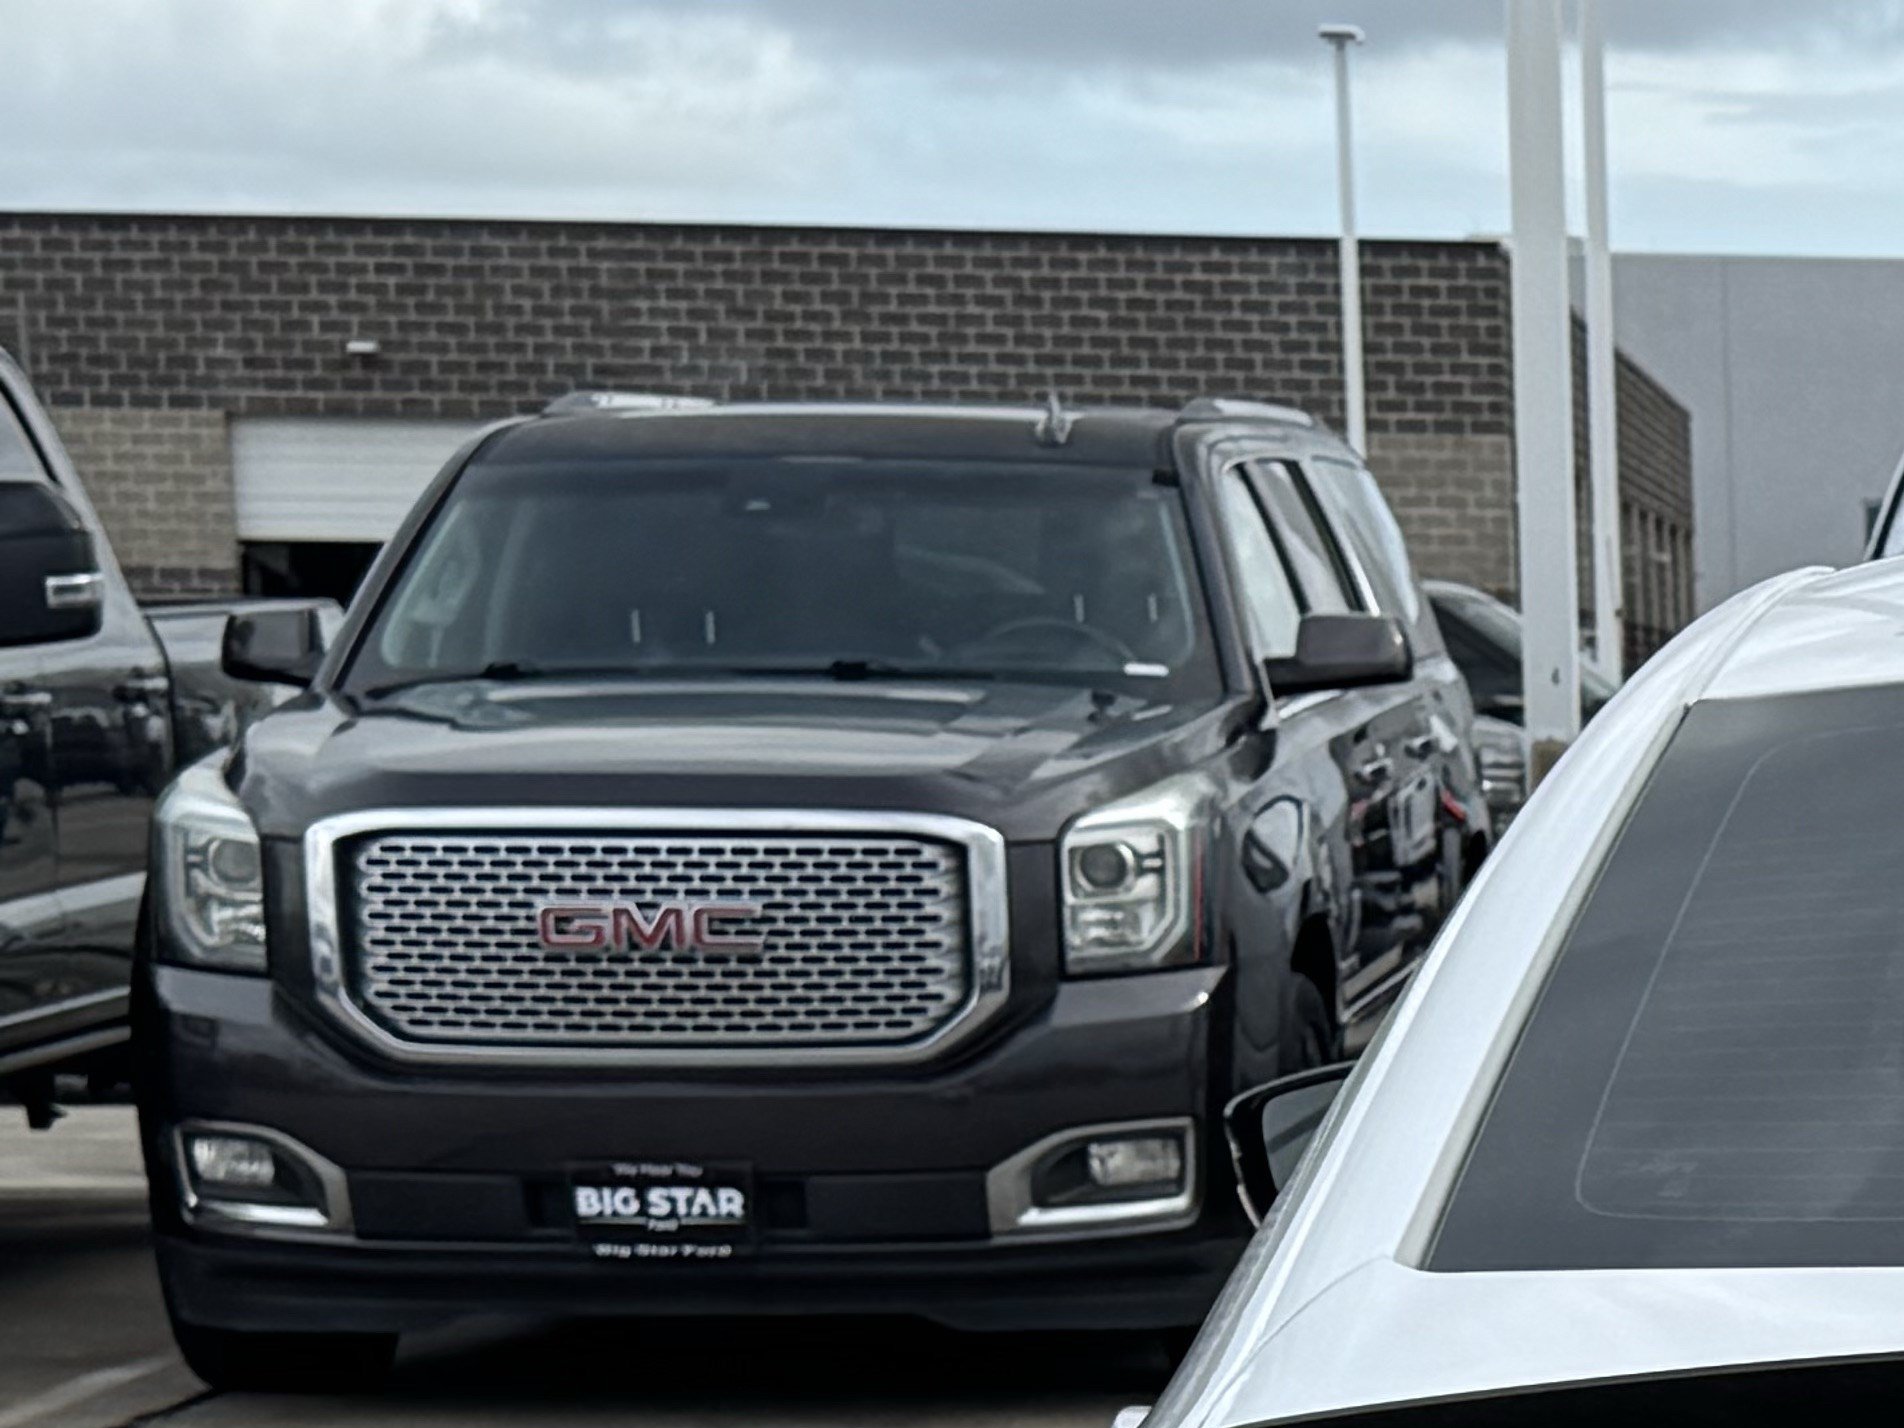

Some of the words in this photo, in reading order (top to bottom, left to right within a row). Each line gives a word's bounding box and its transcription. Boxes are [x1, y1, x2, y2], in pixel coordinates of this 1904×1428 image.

[537, 900, 768, 951] GMC
[575, 1186, 641, 1218] BIG
[646, 1186, 746, 1219] STAR
